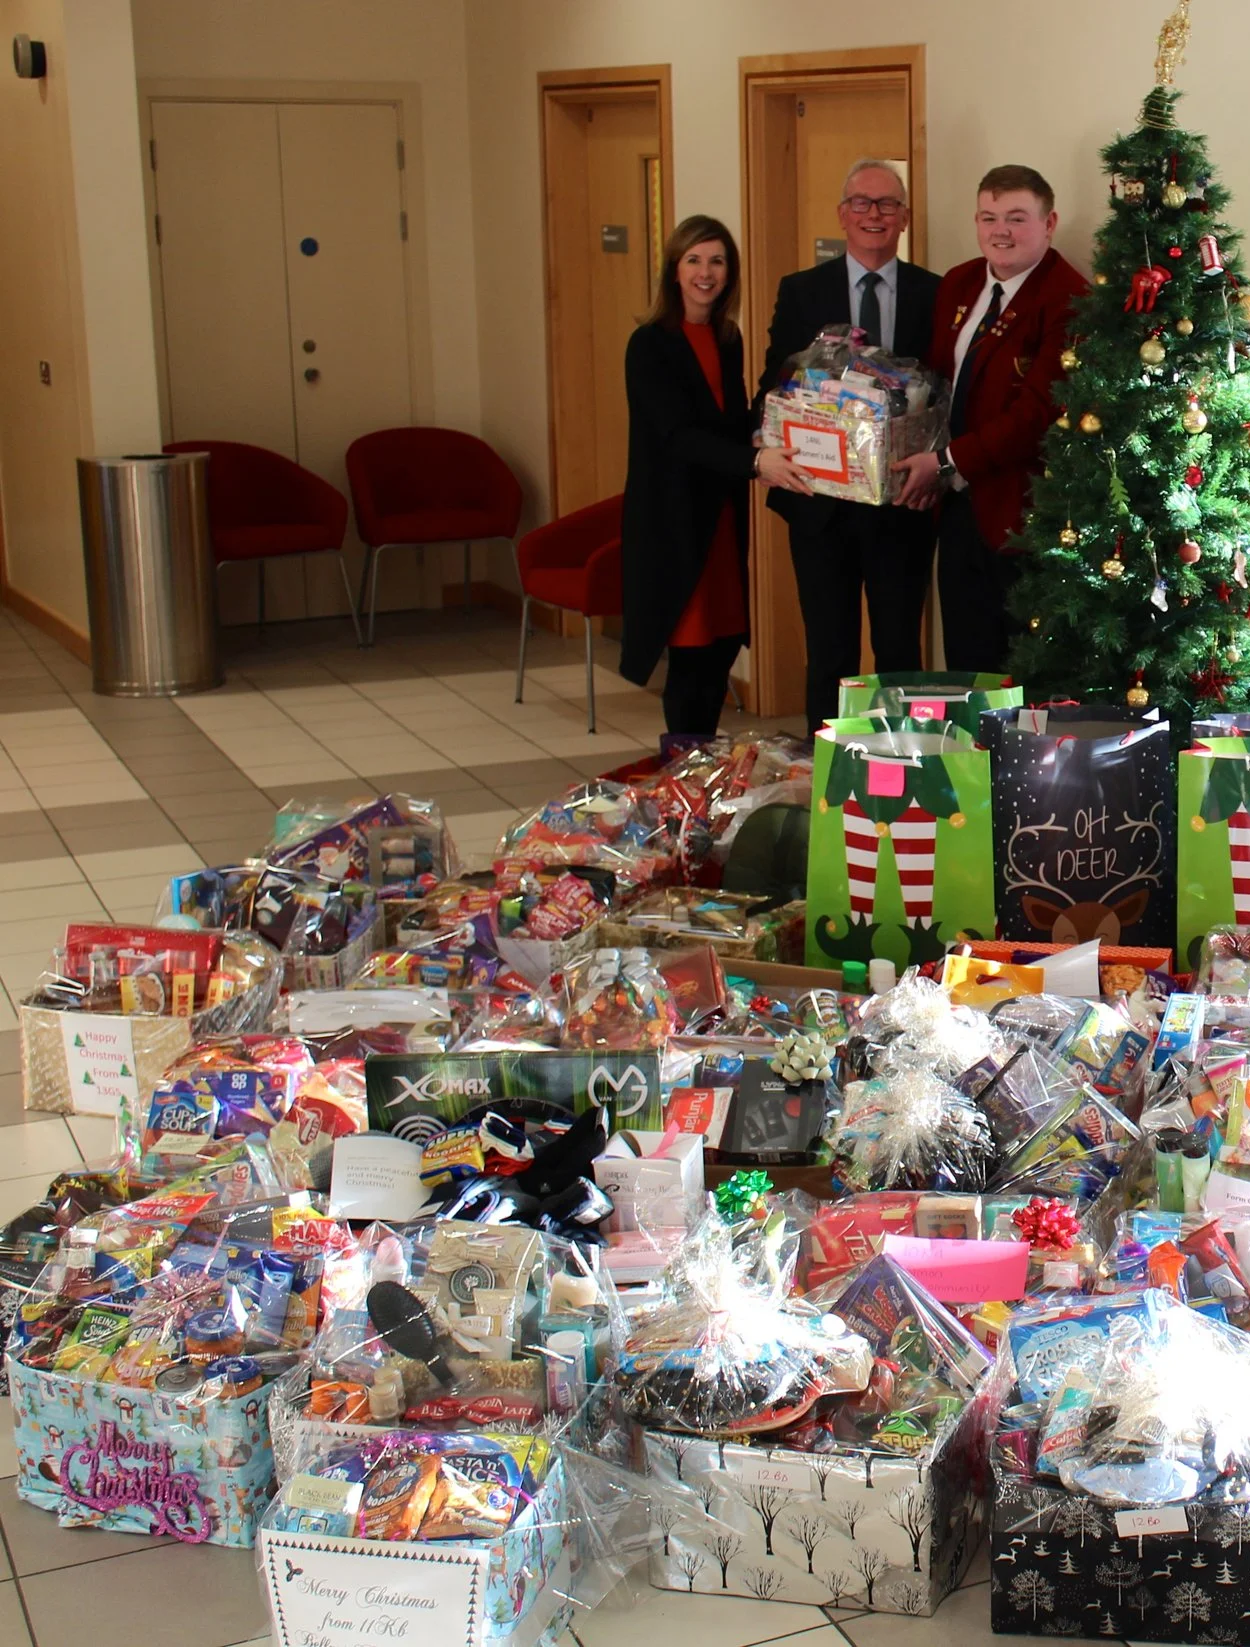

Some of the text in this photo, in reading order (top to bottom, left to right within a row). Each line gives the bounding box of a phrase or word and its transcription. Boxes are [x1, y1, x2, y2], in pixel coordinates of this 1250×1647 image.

[1074, 809, 1108, 839] OH
[1057, 849, 1125, 881] DEER
[85, 1031, 117, 1046] Happy
[80, 1048, 128, 1063] Christmas
[93, 1067, 119, 1079] From
[366, 1174, 393, 1183] merry
[380, 1167, 421, 1178] peaceful
[345, 1179, 395, 1190] Christmas!
[927, 1283, 990, 1298] ommunity
[91, 1316, 117, 1329] HEINZ
[1038, 1325, 1069, 1341] TESCO
[96, 1419, 171, 1476] Merry
[446, 1455, 484, 1469] ASTA
[297, 1577, 439, 1610] Merry Christmas
[317, 1611, 355, 1632] from
